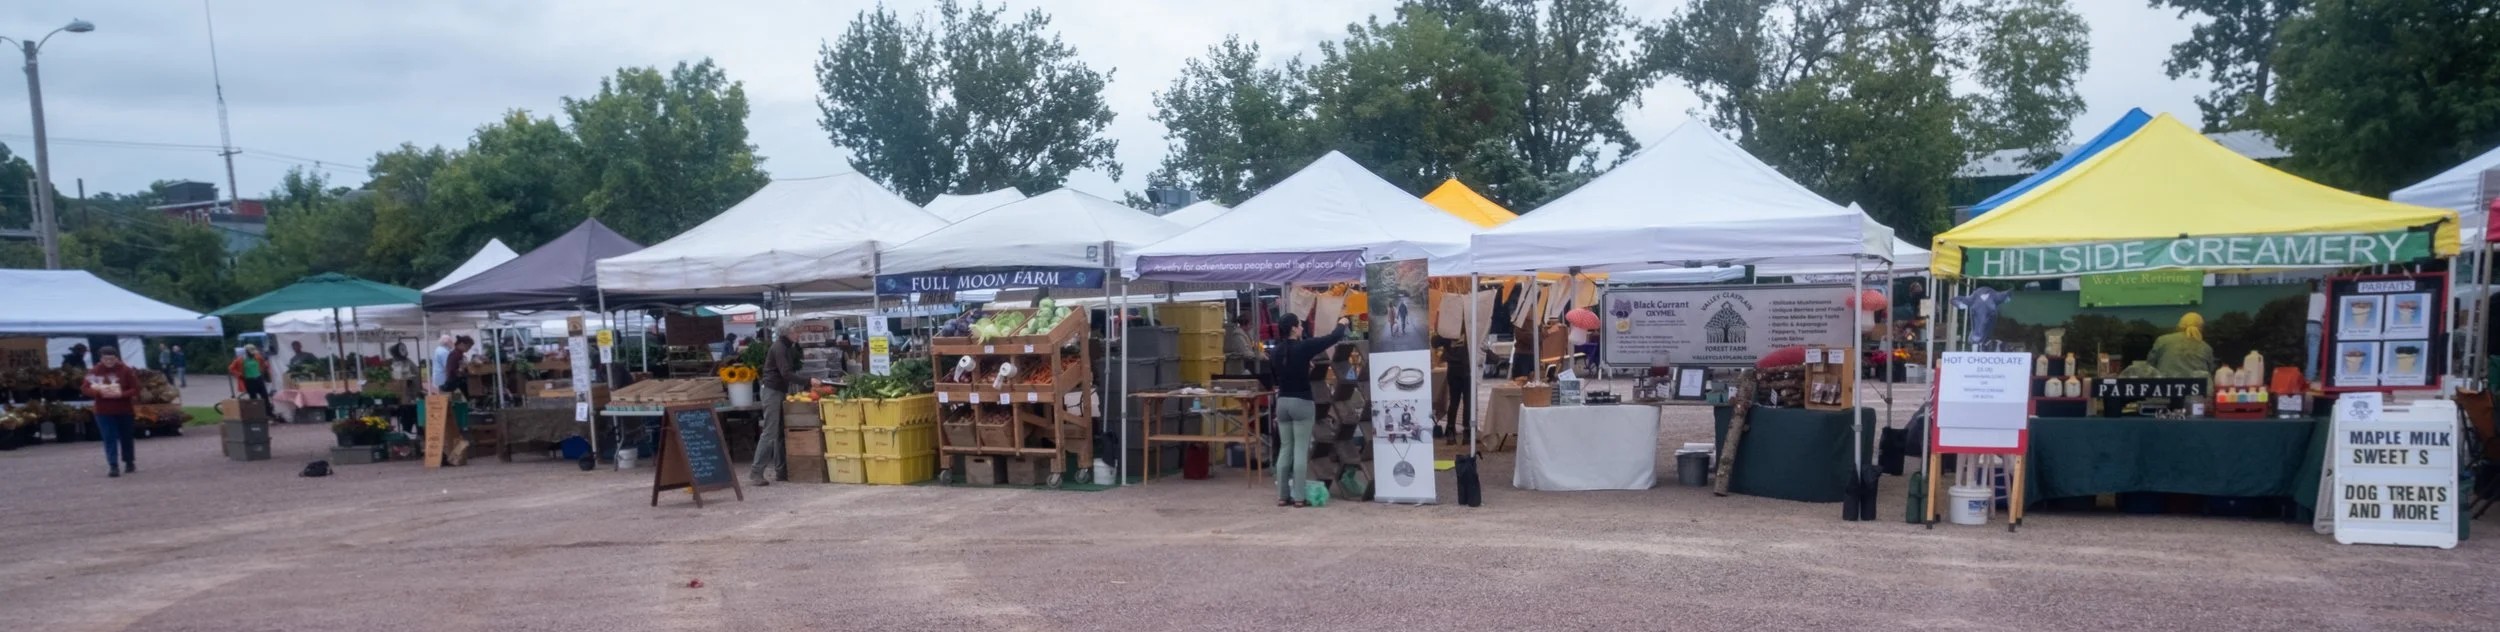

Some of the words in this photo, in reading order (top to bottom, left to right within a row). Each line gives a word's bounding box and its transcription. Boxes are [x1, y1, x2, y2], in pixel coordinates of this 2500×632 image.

[1983, 241, 2145, 275] HILLSIDE
[2169, 233, 2408, 264] CREAMERY
[1183, 262, 1194, 271] for
[1195, 262, 1242, 271] adventurous
[1244, 259, 1272, 271] people
[1274, 260, 1291, 269] and
[1306, 258, 1334, 271] places
[1335, 258, 1353, 270] they
[911, 276, 950, 291] FULL
[957, 273, 1008, 290] MOON
[1012, 271, 1060, 286] FARM
[2092, 274, 2112, 285] We
[2115, 274, 2137, 284] Are
[2141, 273, 2191, 284] Retiring
[2362, 282, 2413, 290] PARFAITS
[1633, 301, 1655, 309] Black
[1657, 301, 1689, 309] Currant
[1701, 293, 1721, 311] VALLEY
[1722, 292, 1753, 311] CLAYPLAIN
[1943, 356, 1962, 364] HOT
[1967, 356, 2024, 365] CHOCOLATE
[2098, 383, 2200, 397] PARFAITS
[2350, 431, 2401, 445] MAPLE
[2409, 431, 2450, 446] MILK
[2353, 449, 2409, 464] SWEET
[2419, 449, 2429, 465] S
[2345, 484, 2377, 500] DOG
[2387, 485, 2447, 502] TREATS
[2349, 503, 2380, 519] AND
[2392, 504, 2439, 520] MORE
